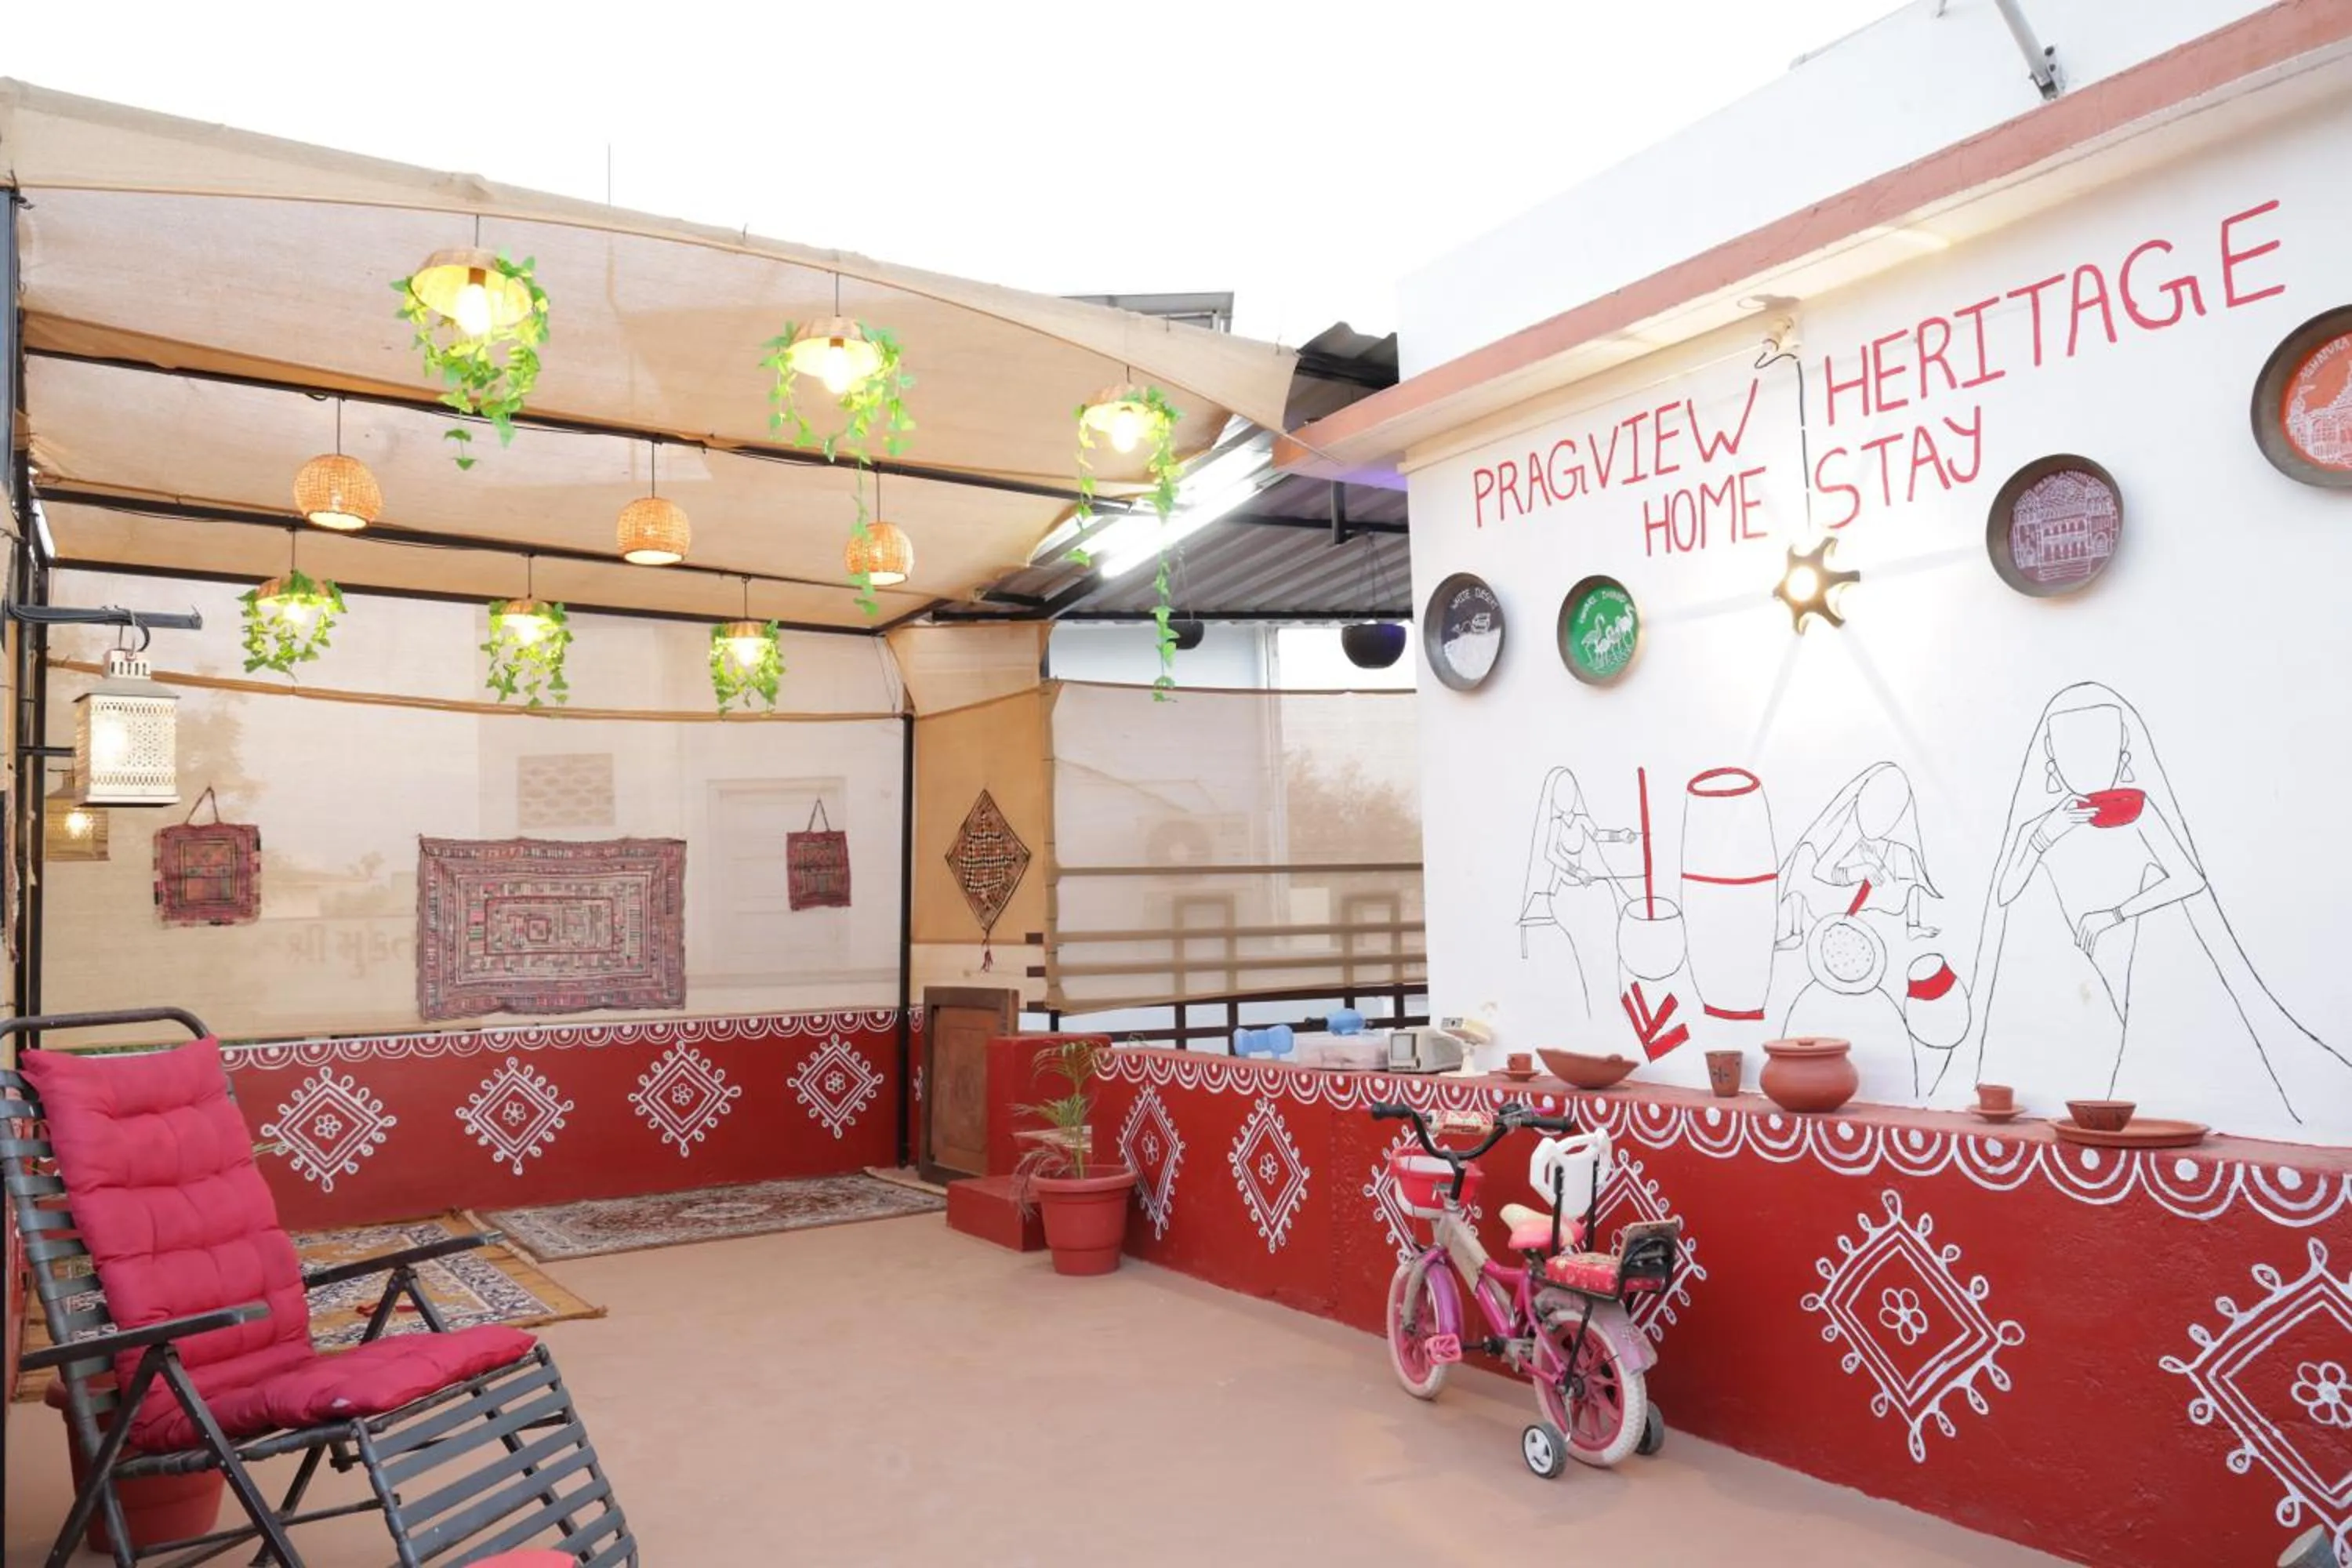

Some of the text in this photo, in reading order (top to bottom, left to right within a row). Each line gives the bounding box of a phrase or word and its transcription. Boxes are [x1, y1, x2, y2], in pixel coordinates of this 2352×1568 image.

[1473, 199, 2286, 528] PRAGVIEW HERITAGE
[1643, 405, 1982, 557] HOME STAY
